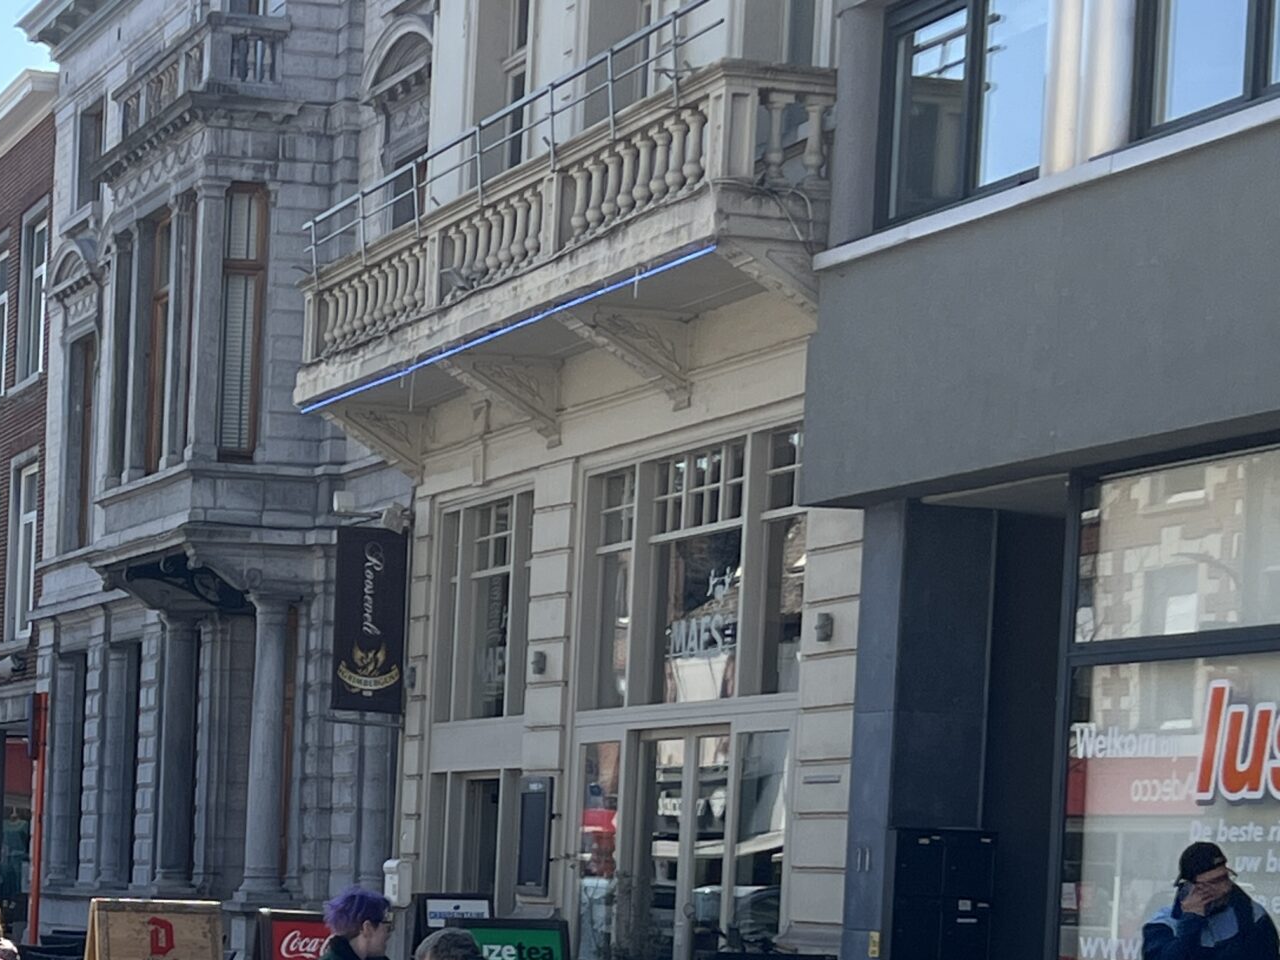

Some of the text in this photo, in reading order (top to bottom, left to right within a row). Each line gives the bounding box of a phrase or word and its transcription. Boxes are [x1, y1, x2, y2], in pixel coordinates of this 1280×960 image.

[362, 541, 384, 636] Roosevelt
[1075, 725, 1157, 759] Welkom
[1189, 819, 1212, 842] De
[1217, 818, 1265, 842] beste
[1234, 855, 1262, 873] uw
